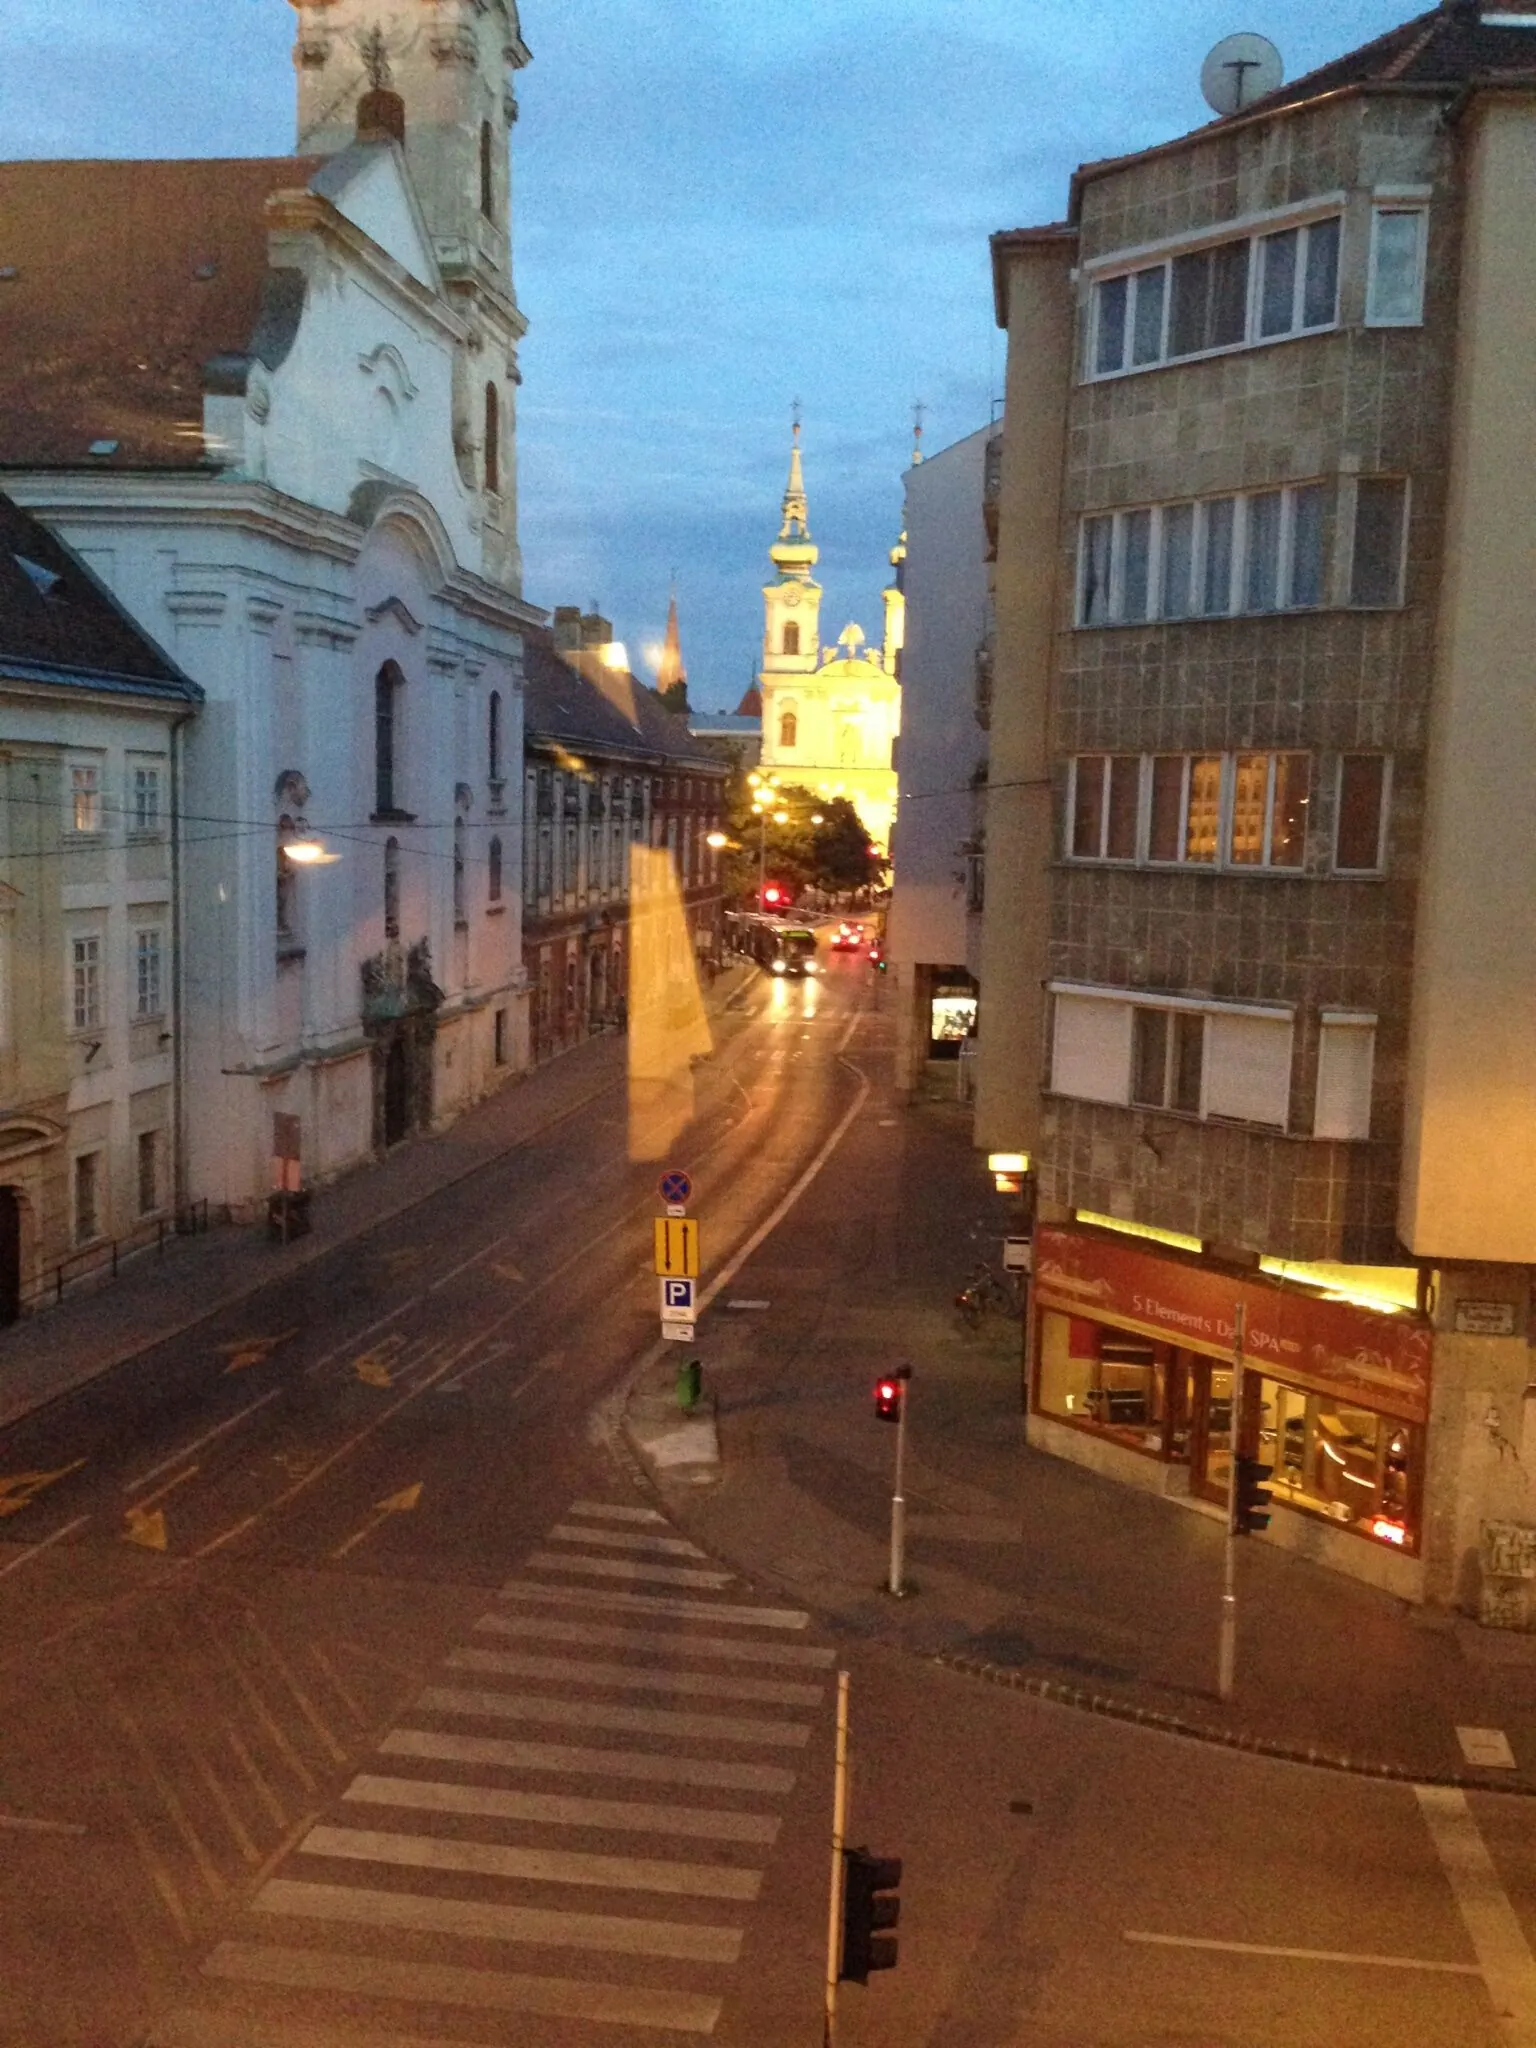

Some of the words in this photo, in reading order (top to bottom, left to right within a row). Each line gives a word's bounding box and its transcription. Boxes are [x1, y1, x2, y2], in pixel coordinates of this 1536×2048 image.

[669, 1282, 687, 1305] P
[1132, 1295, 1144, 1312] 5
[1146, 1299, 1212, 1333] Elements
[1216, 1319, 1244, 1341] Da
[1250, 1329, 1280, 1352] SPA
